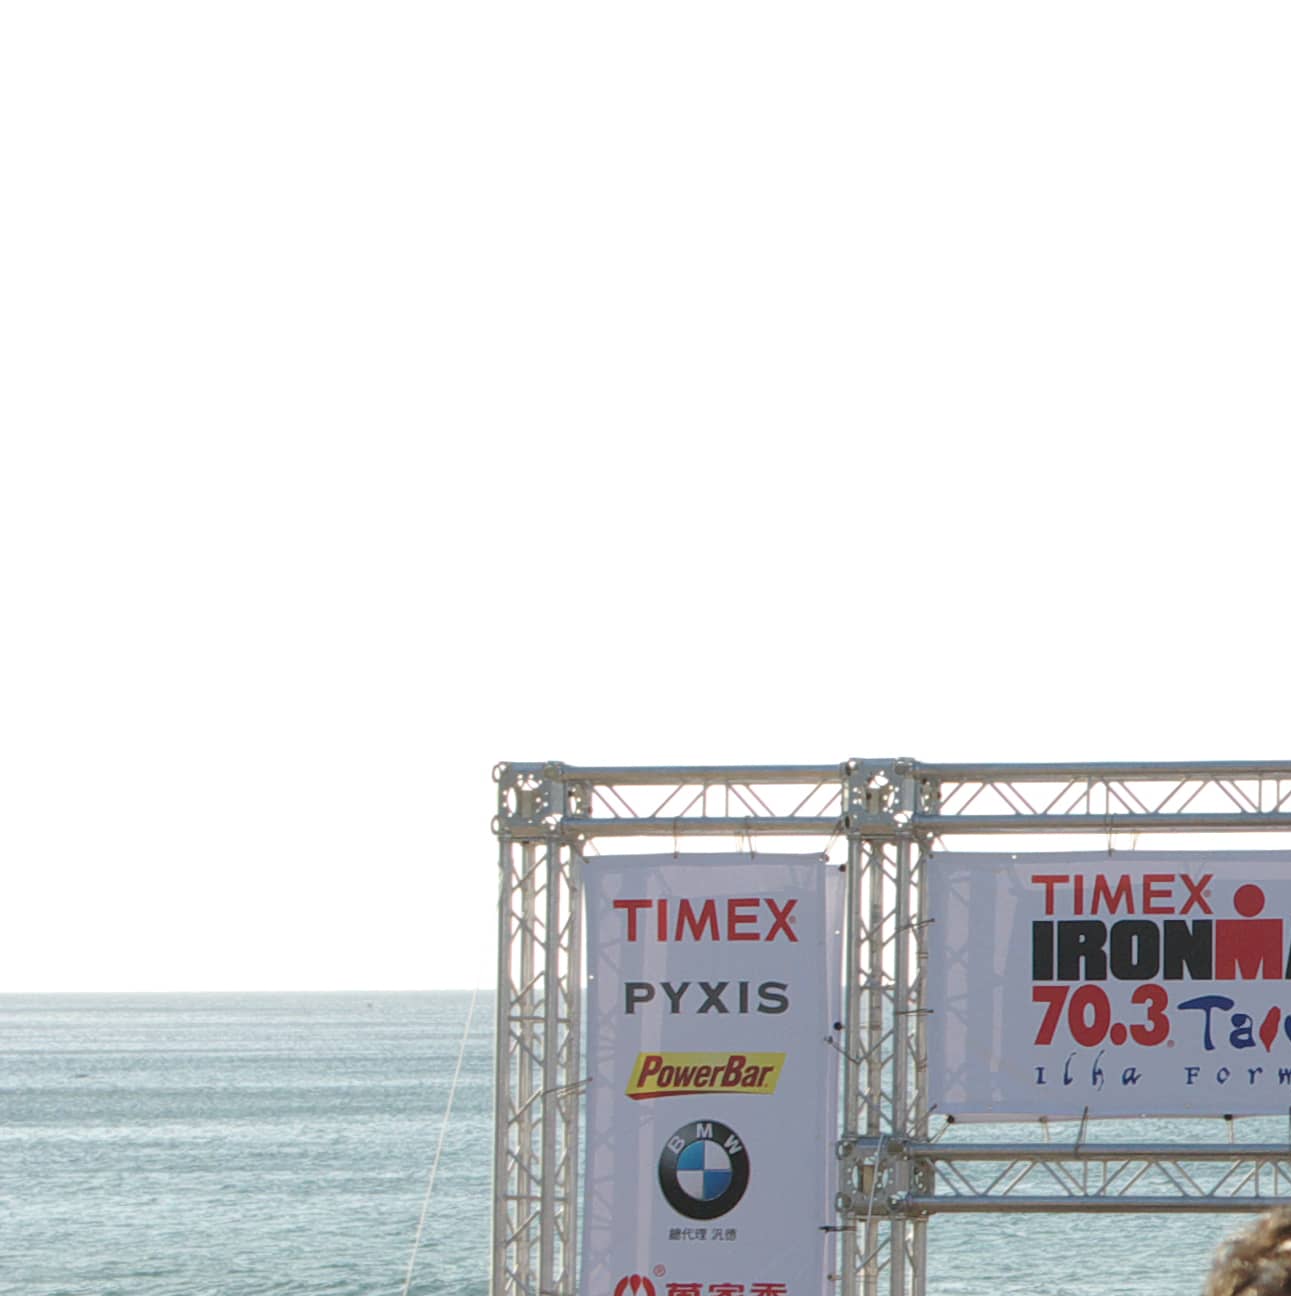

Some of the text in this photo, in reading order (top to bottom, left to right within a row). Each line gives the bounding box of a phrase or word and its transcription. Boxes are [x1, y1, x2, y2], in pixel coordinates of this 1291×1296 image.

[1031, 873, 1214, 915] TIMEX
[613, 898, 798, 942] TIMEX
[624, 981, 789, 1014] PYXIS
[1031, 983, 1171, 1048] 70.3
[637, 1055, 775, 1088] PowerBar
[668, 1123, 742, 1155] BMW
